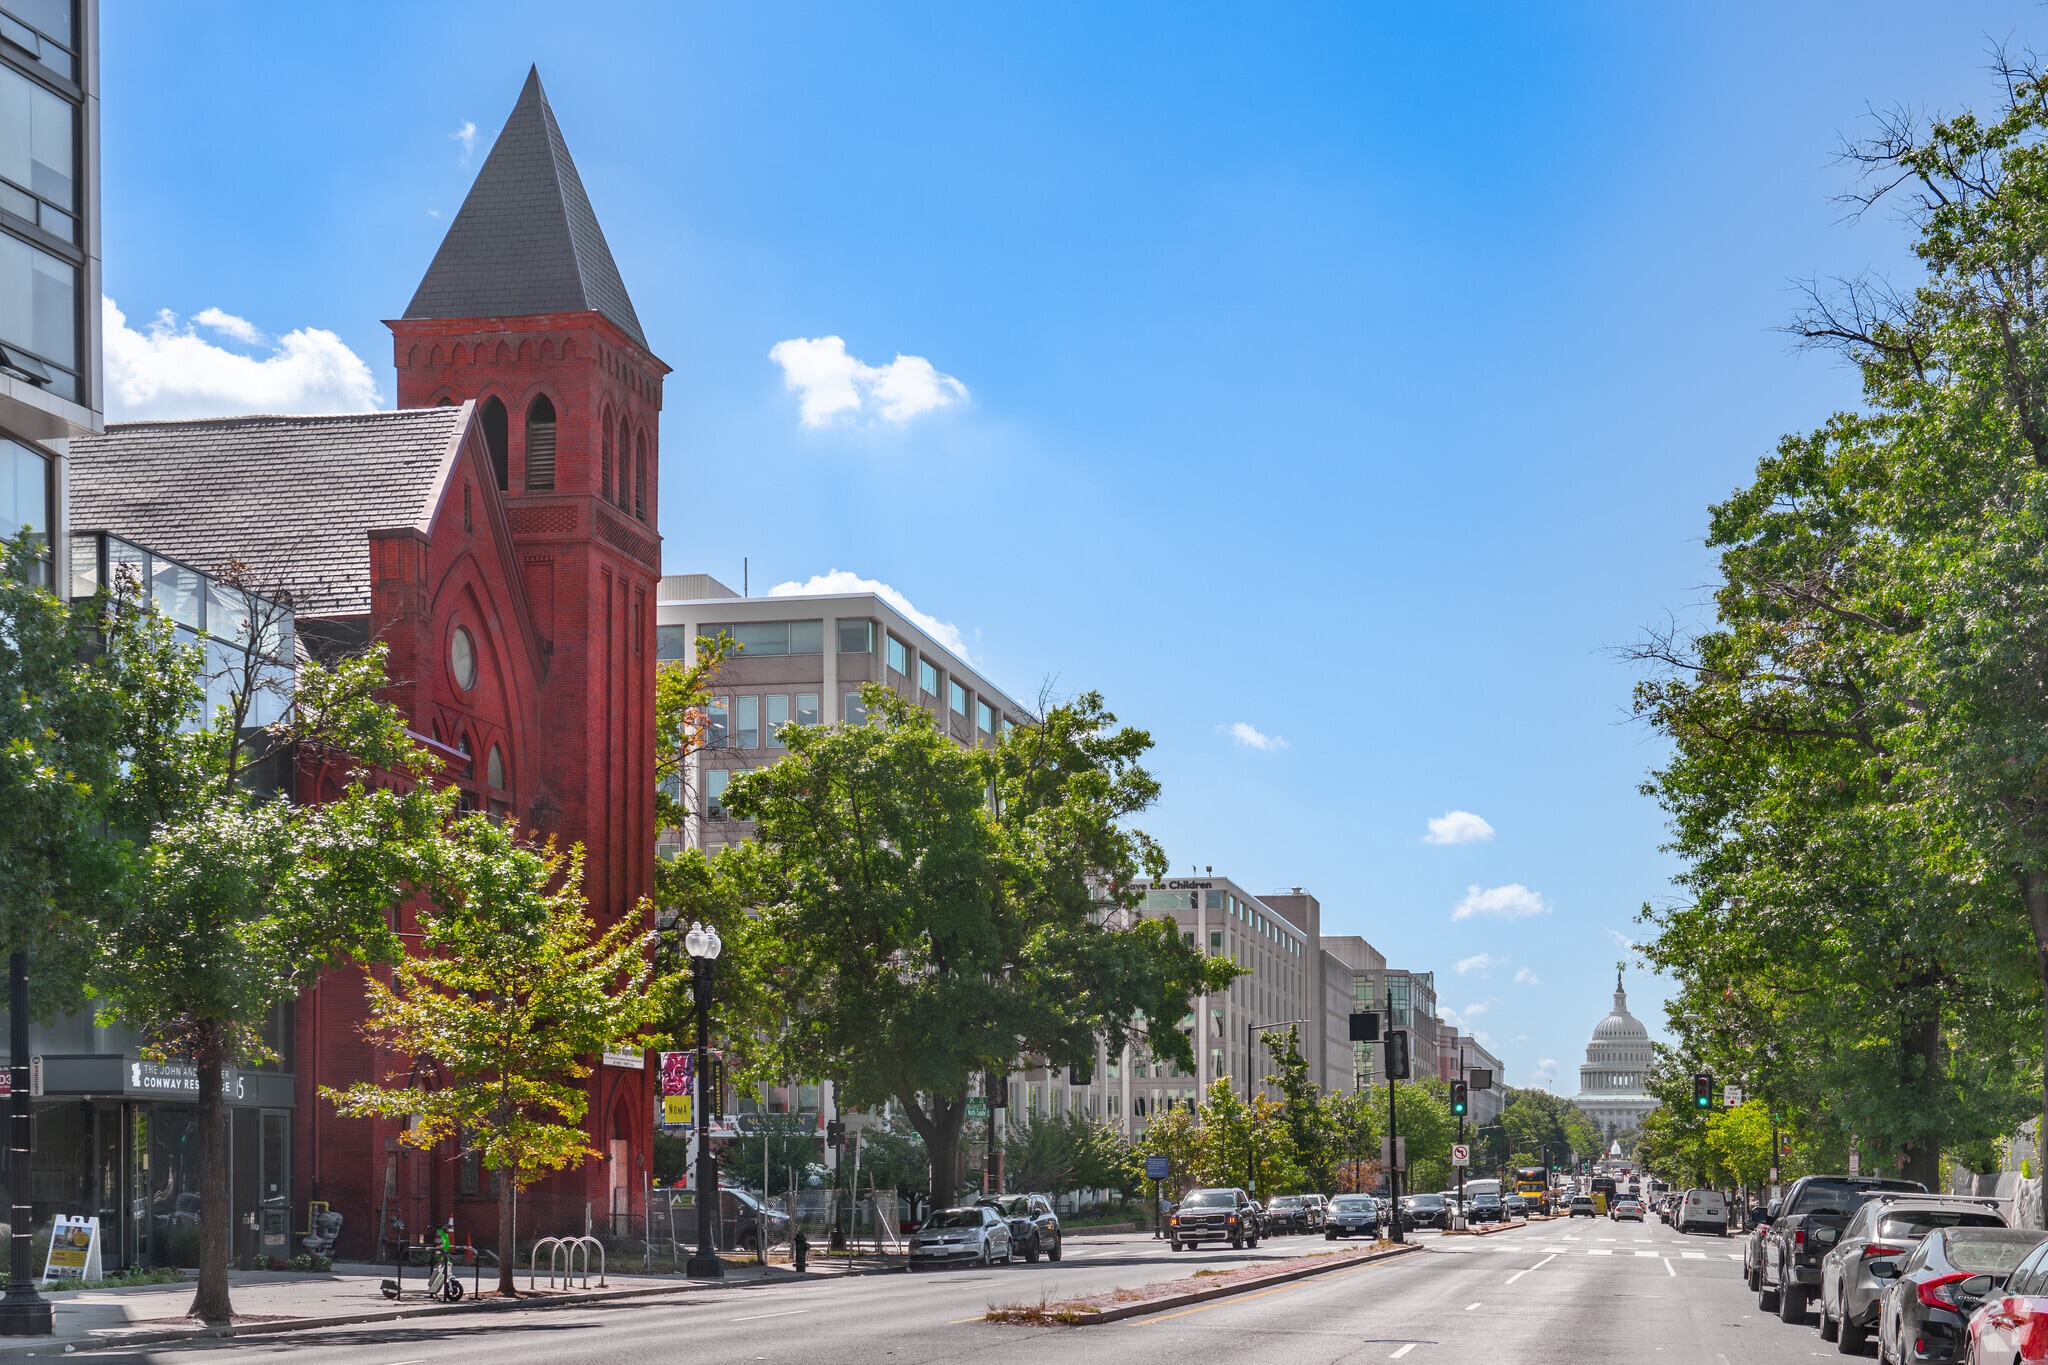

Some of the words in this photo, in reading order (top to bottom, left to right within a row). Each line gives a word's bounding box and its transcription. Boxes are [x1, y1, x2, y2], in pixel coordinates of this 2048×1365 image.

[1169, 880, 1212, 890] Children
[144, 1065, 158, 1075] THE
[160, 1066, 181, 1076] JOHN
[144, 1077, 182, 1089] CONWAY
